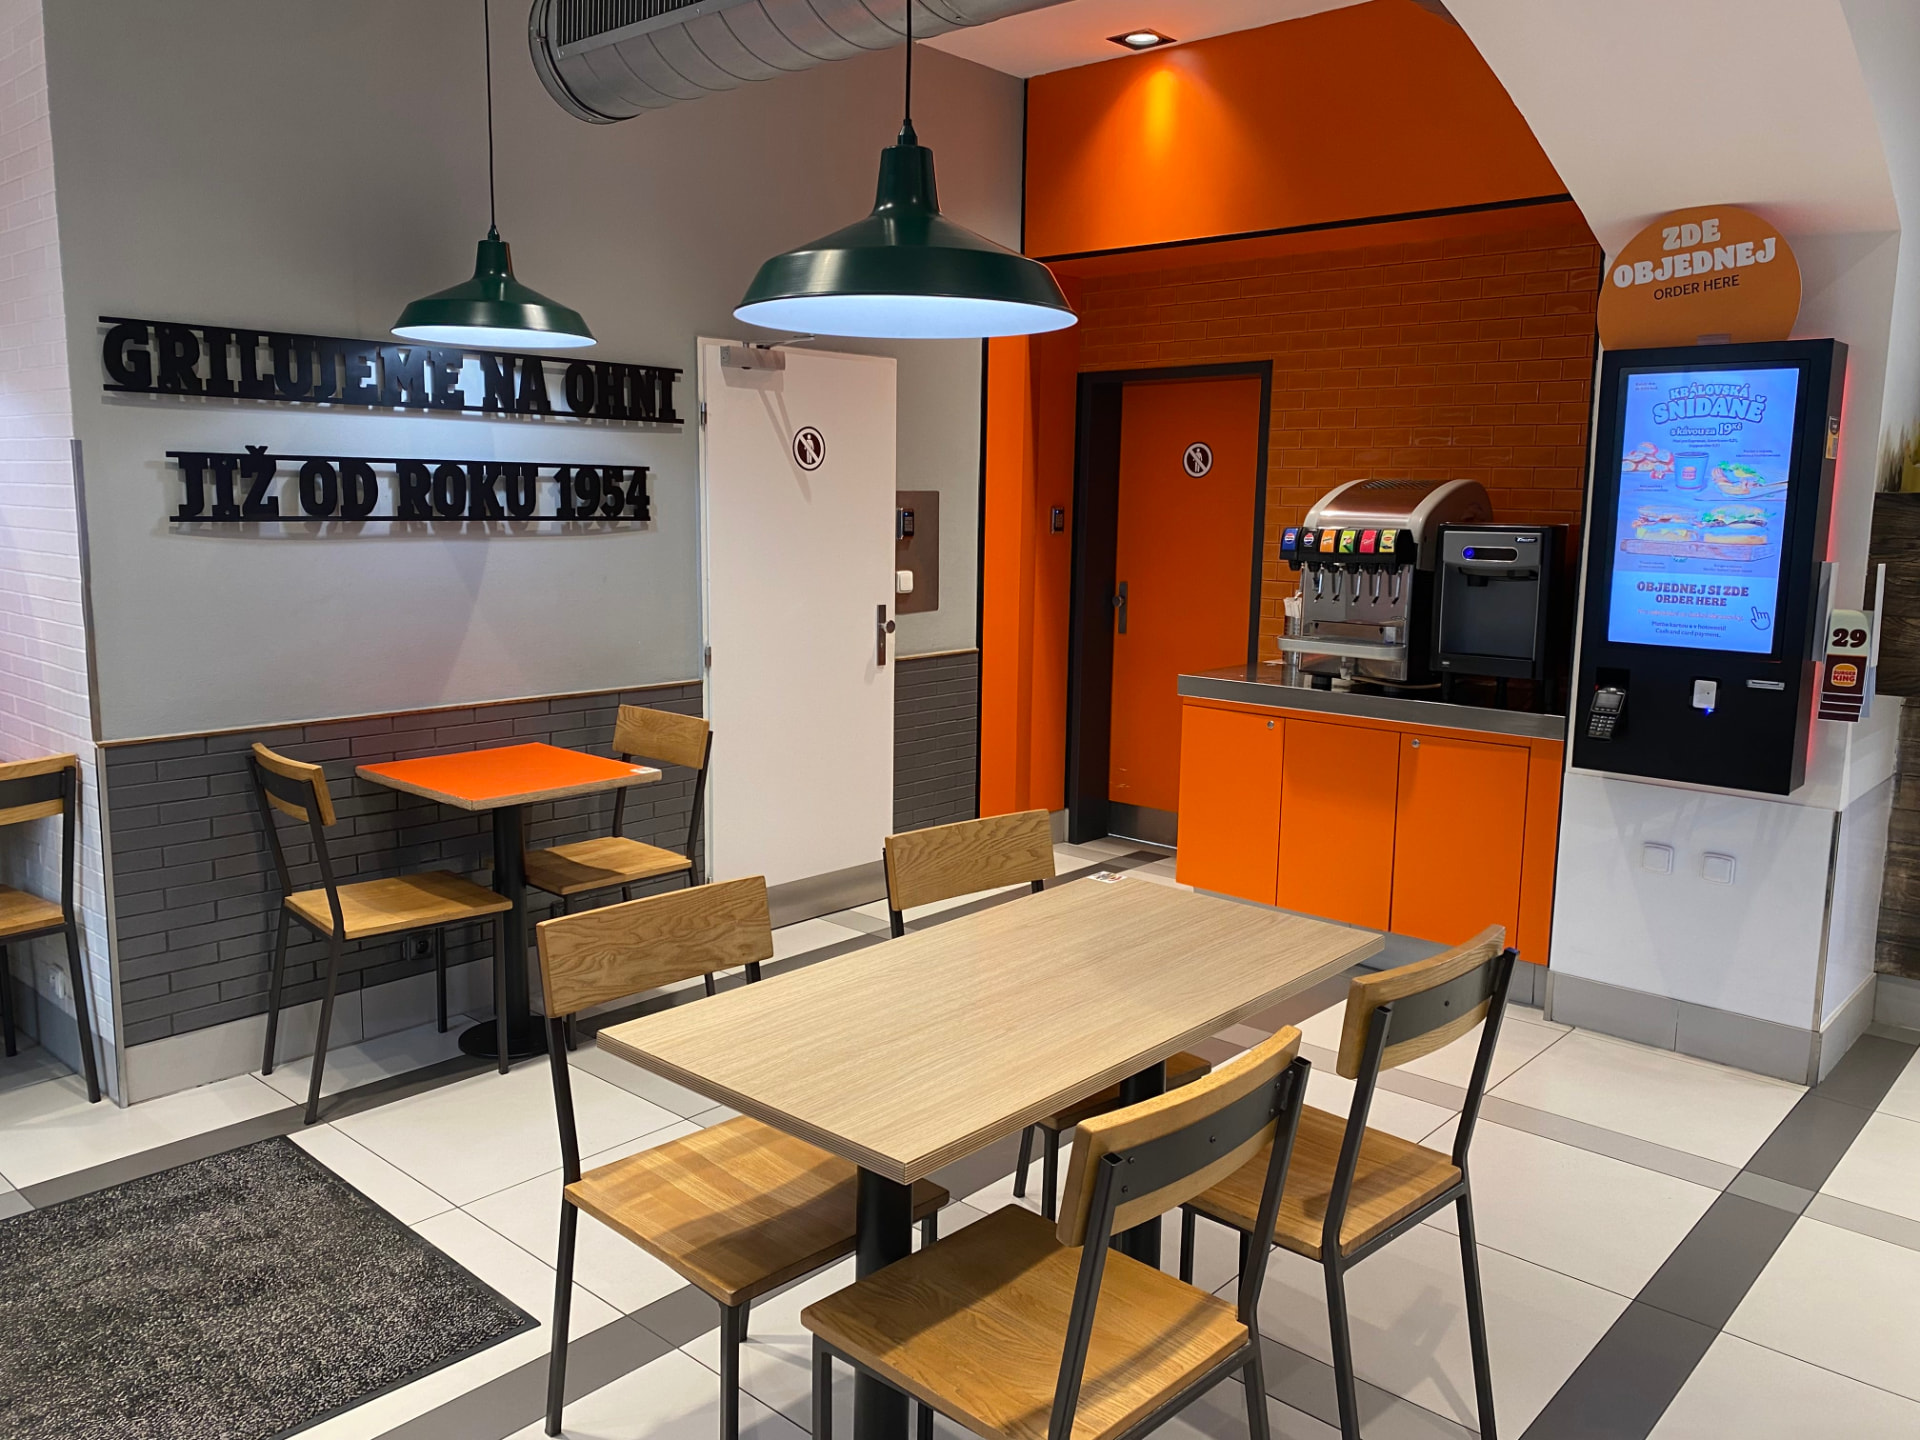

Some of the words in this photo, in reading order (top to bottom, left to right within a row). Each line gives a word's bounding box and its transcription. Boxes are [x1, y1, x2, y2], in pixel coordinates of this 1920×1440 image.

[1662, 218, 1721, 250] ZDE
[1613, 237, 1776, 288] OBJEDNEJ
[1654, 281, 1700, 300] ORDER
[1703, 274, 1740, 292] HERE
[102, 322, 464, 408] GRILUJEME
[483, 352, 549, 412] NA
[565, 363, 679, 421] OHNI
[1669, 382, 1750, 400] KRÁLOVSKÁ
[1653, 394, 1767, 424] SNÍDANĚ
[177, 445, 279, 518] JIŽ
[300, 459, 379, 518] OD
[398, 462, 540, 519] ROKU
[553, 466, 650, 519] 1954
[1637, 581, 1706, 595] OBJEDNEJ
[1707, 584, 1722, 596] SI
[1723, 585, 1749, 597] ZDE
[1656, 594, 1694, 605] ORDER
[1696, 596, 1727, 607] HERE
[1832, 628, 1867, 648] 29
